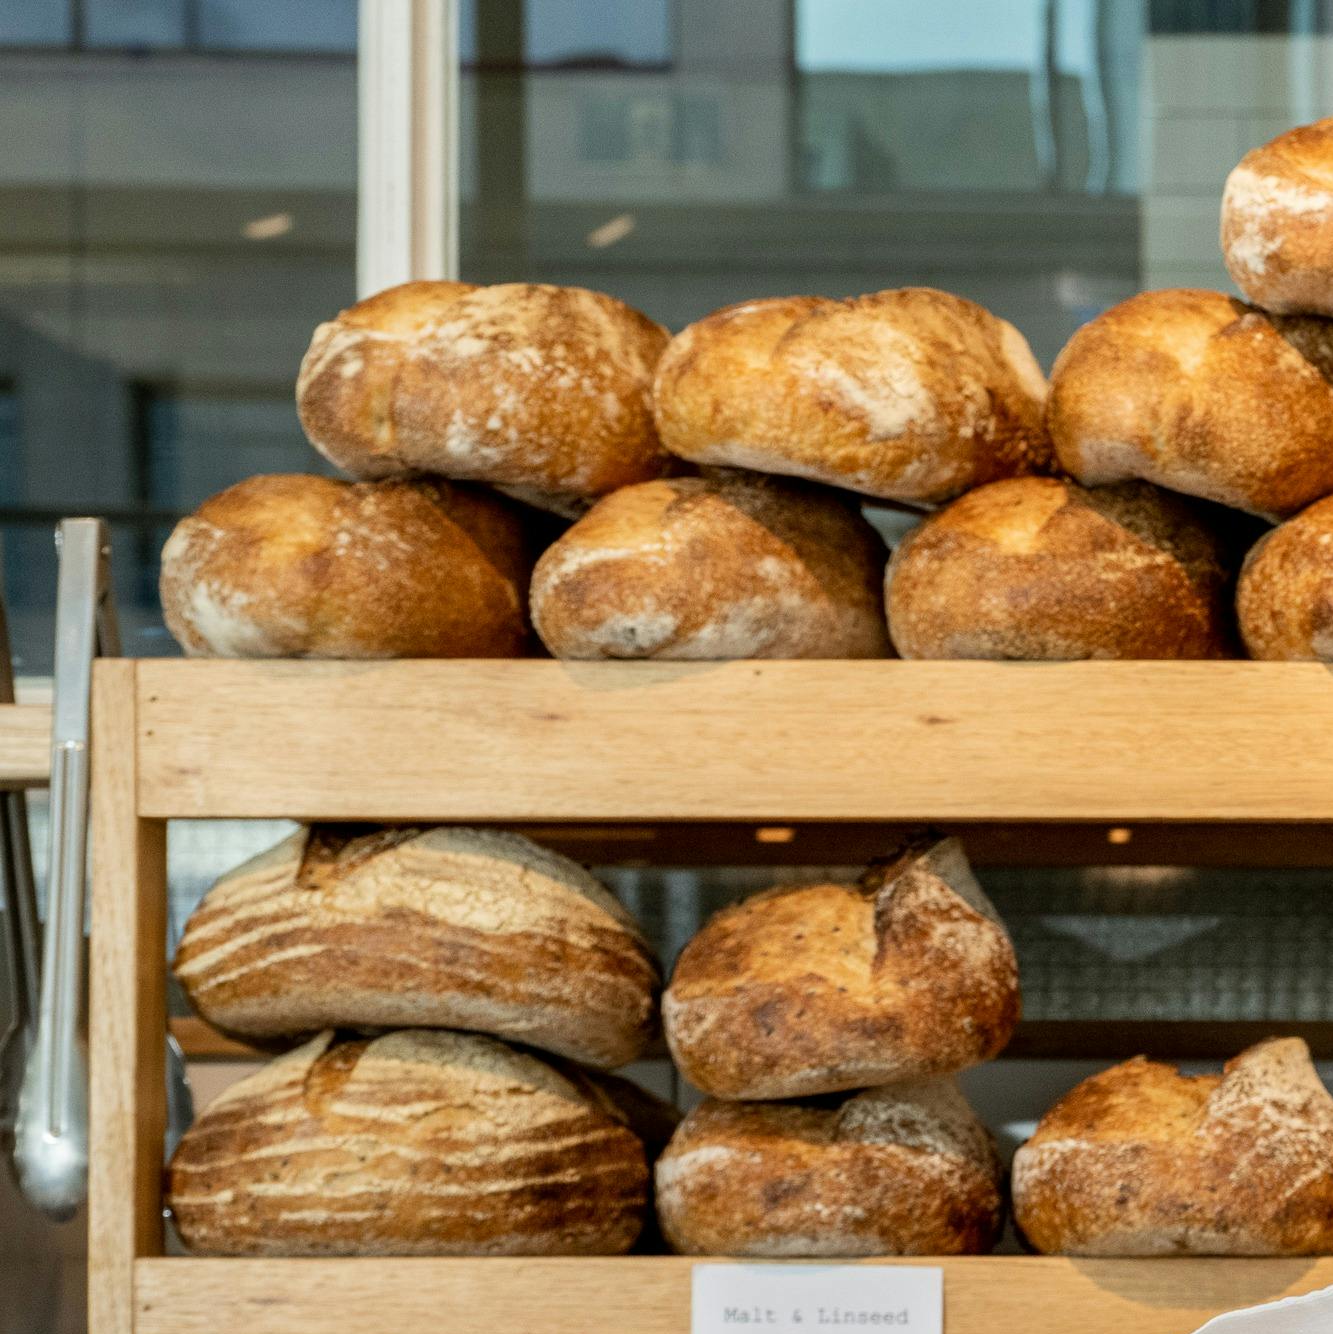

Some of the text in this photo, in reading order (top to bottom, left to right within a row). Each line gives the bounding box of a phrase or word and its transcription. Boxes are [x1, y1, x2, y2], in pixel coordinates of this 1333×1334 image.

[723, 1307, 909, 1326] Malt & Linseed
